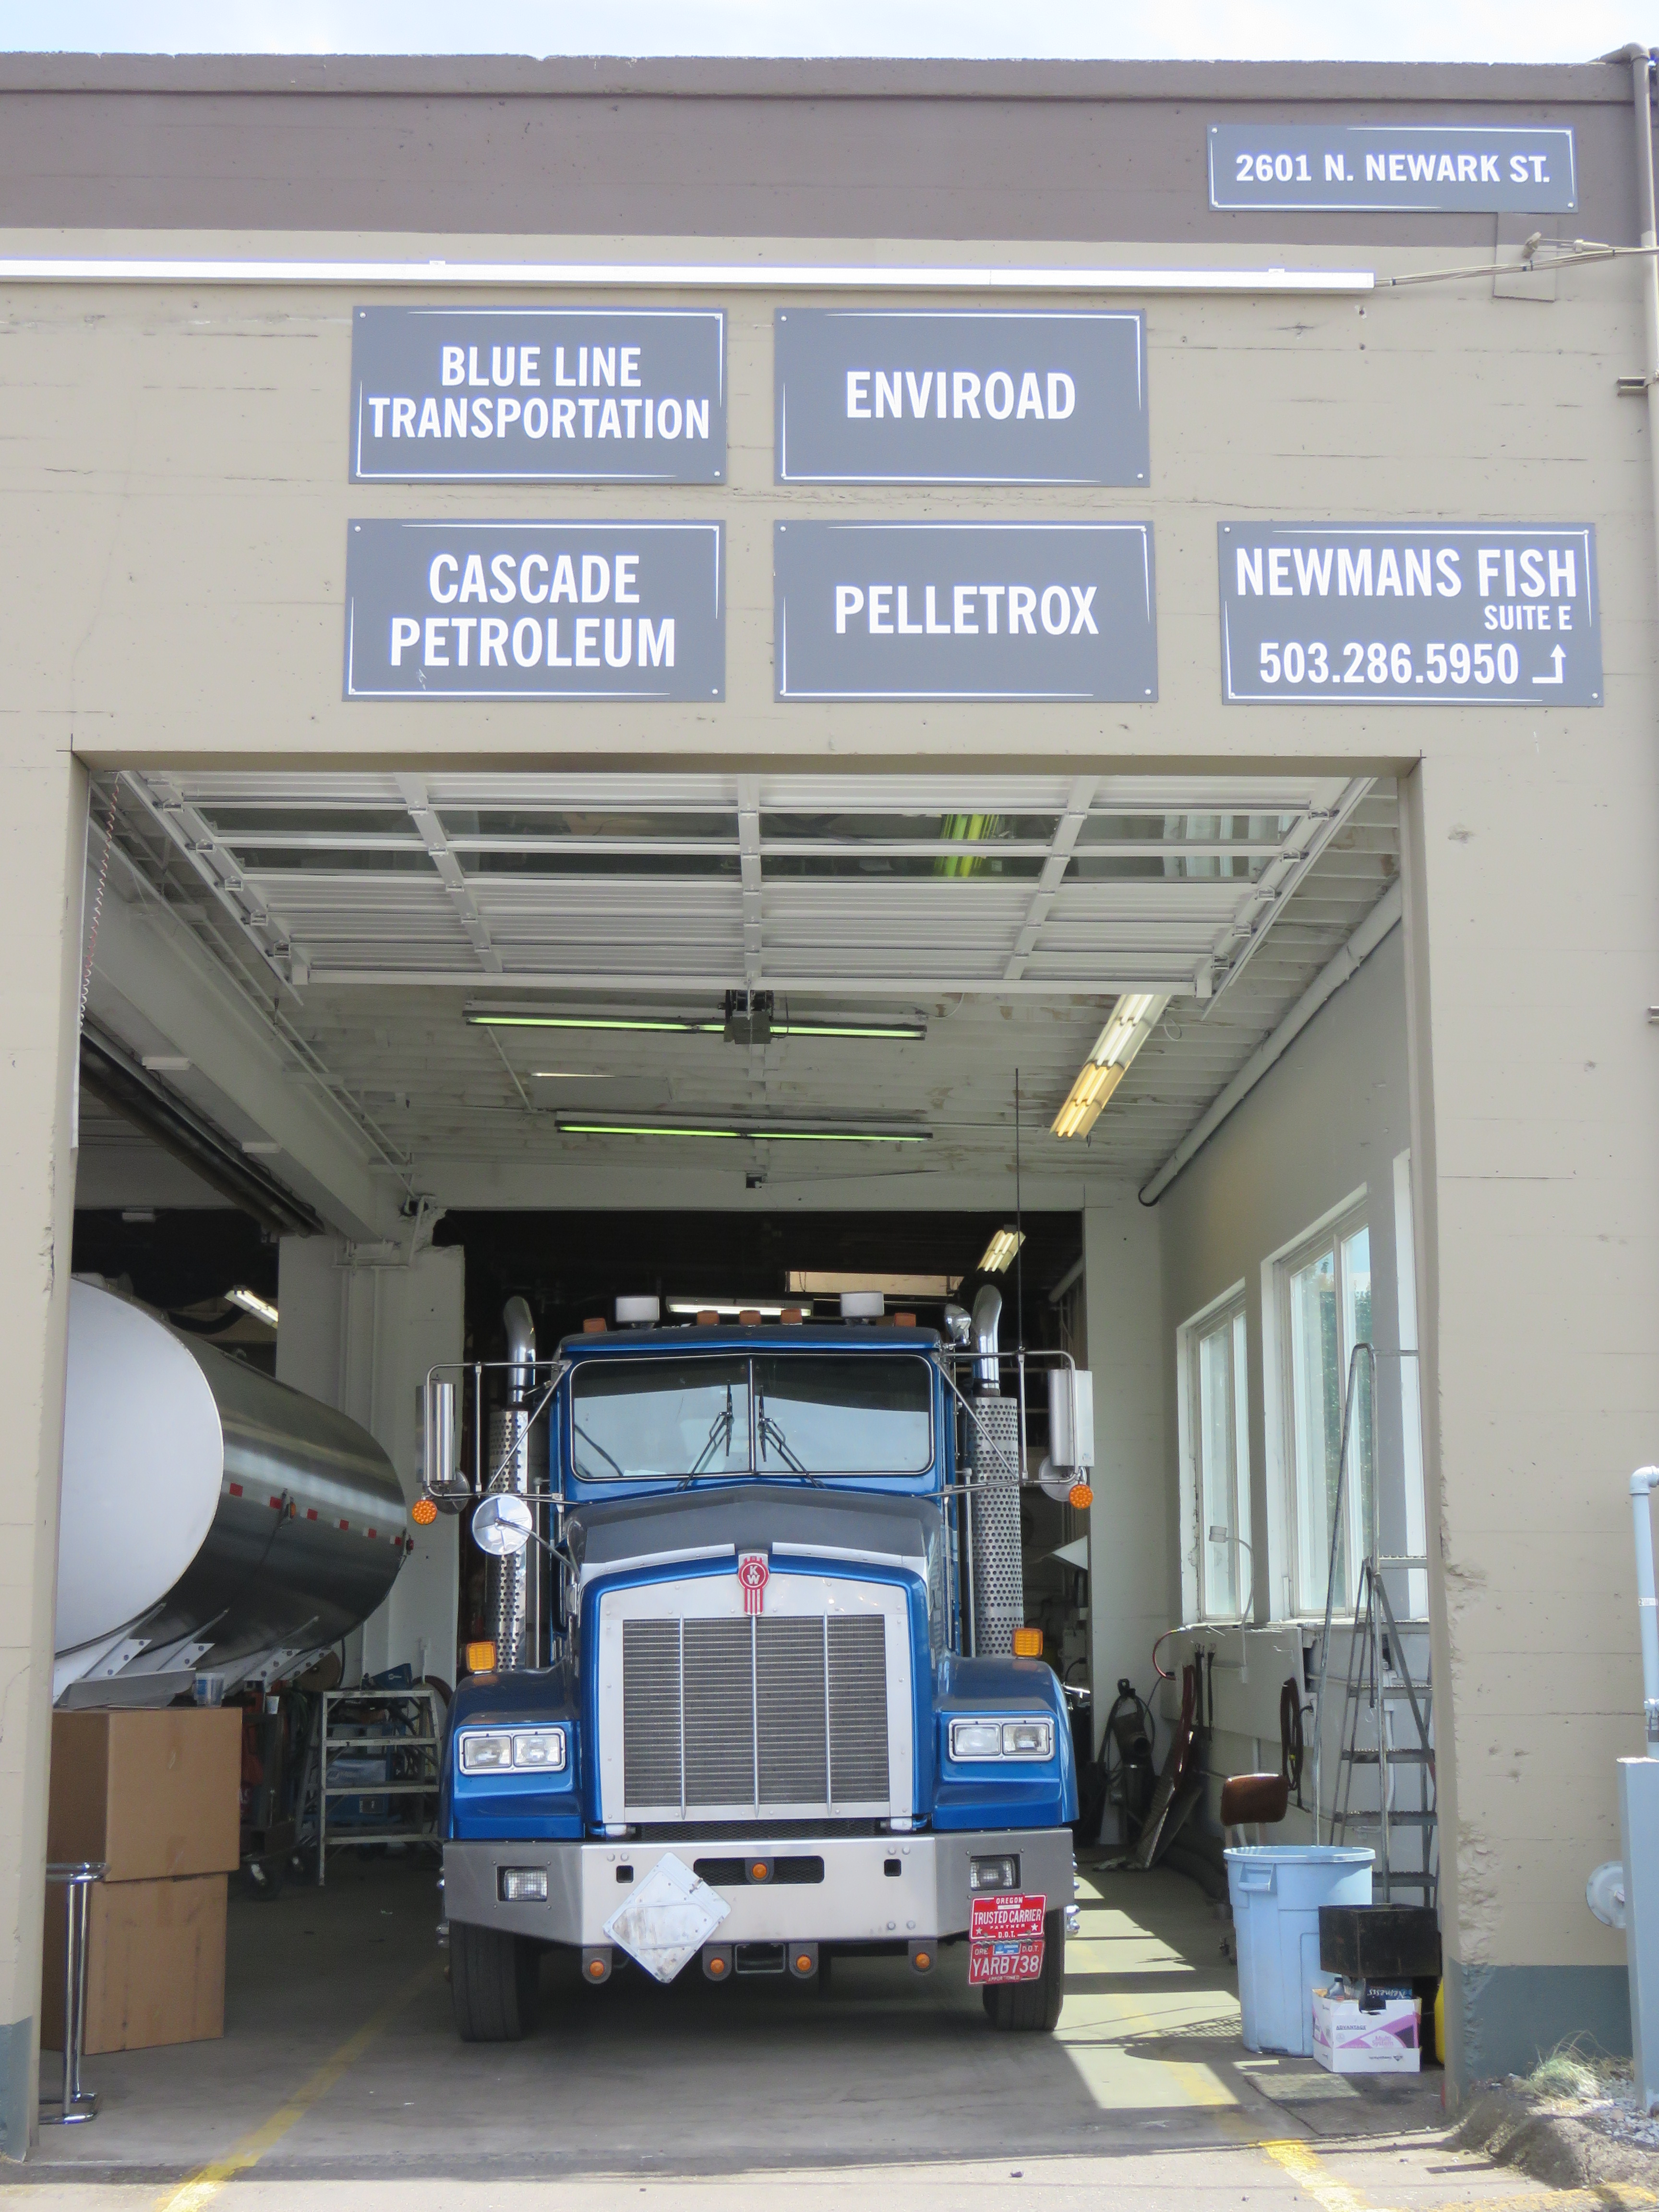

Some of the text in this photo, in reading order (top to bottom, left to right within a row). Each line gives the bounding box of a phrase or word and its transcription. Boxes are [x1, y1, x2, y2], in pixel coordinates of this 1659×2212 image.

[1236, 154, 1551, 183] 2601 N. NEWARK ST.
[441, 346, 642, 387] BLUE LINE
[846, 371, 1076, 421] ENVIROAD
[368, 397, 709, 440] TRANSPORTATION
[428, 553, 641, 604] CASCADE
[1236, 547, 1577, 598] NEWMANS FISH
[835, 585, 1100, 636] PELLETROX
[1483, 604, 1574, 631] SUITE E
[390, 617, 676, 668] PETROLEUM
[1260, 641, 1519, 685] 503.286.5950
[974, 1908, 1042, 1925] TRUSTED CARRIER
[973, 1955, 1039, 1976] YARB738
[1368, 1988, 1406, 2000] Nemesis
